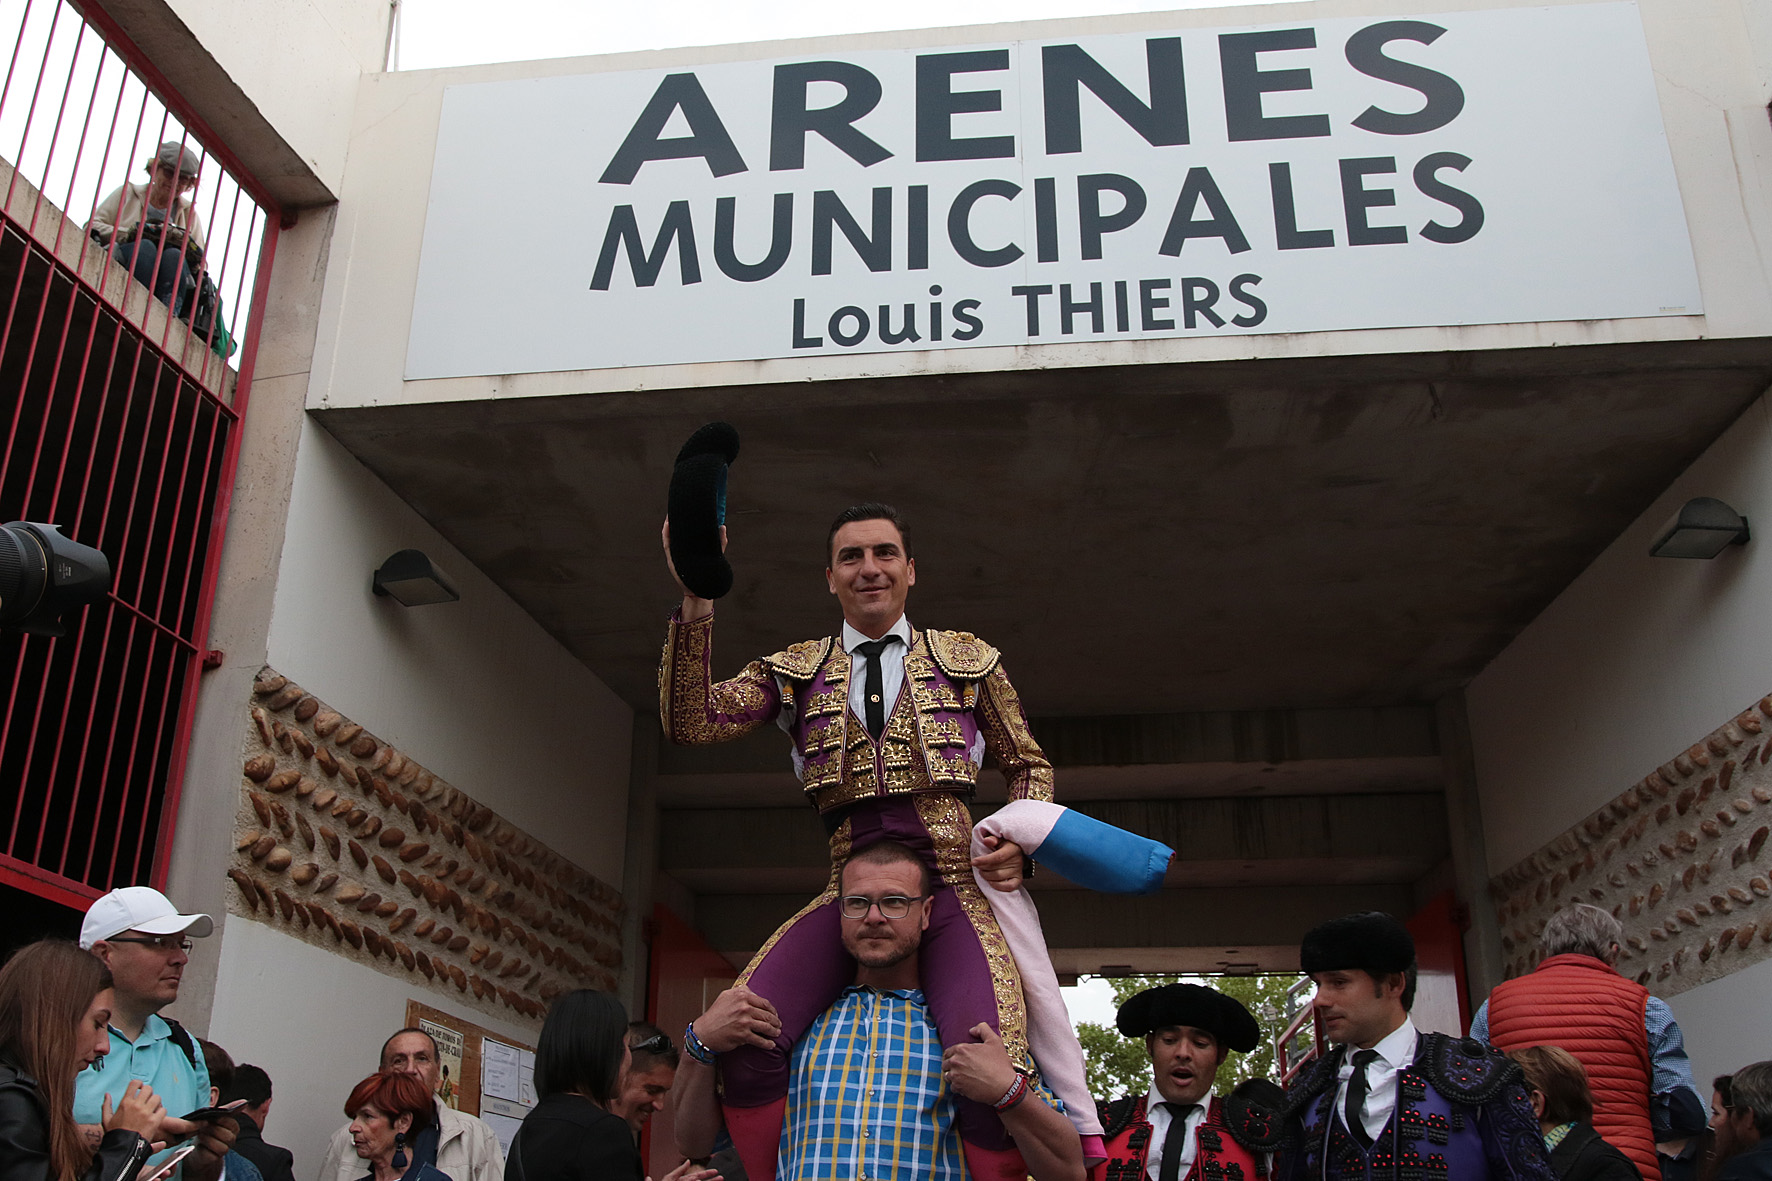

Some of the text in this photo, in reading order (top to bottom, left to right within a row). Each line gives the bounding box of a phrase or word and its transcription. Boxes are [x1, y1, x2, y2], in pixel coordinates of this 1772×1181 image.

[598, 20, 1465, 185] ARENES
[589, 151, 1485, 291] MUNICIPALES
[792, 273, 1268, 349] Louis THIERS
